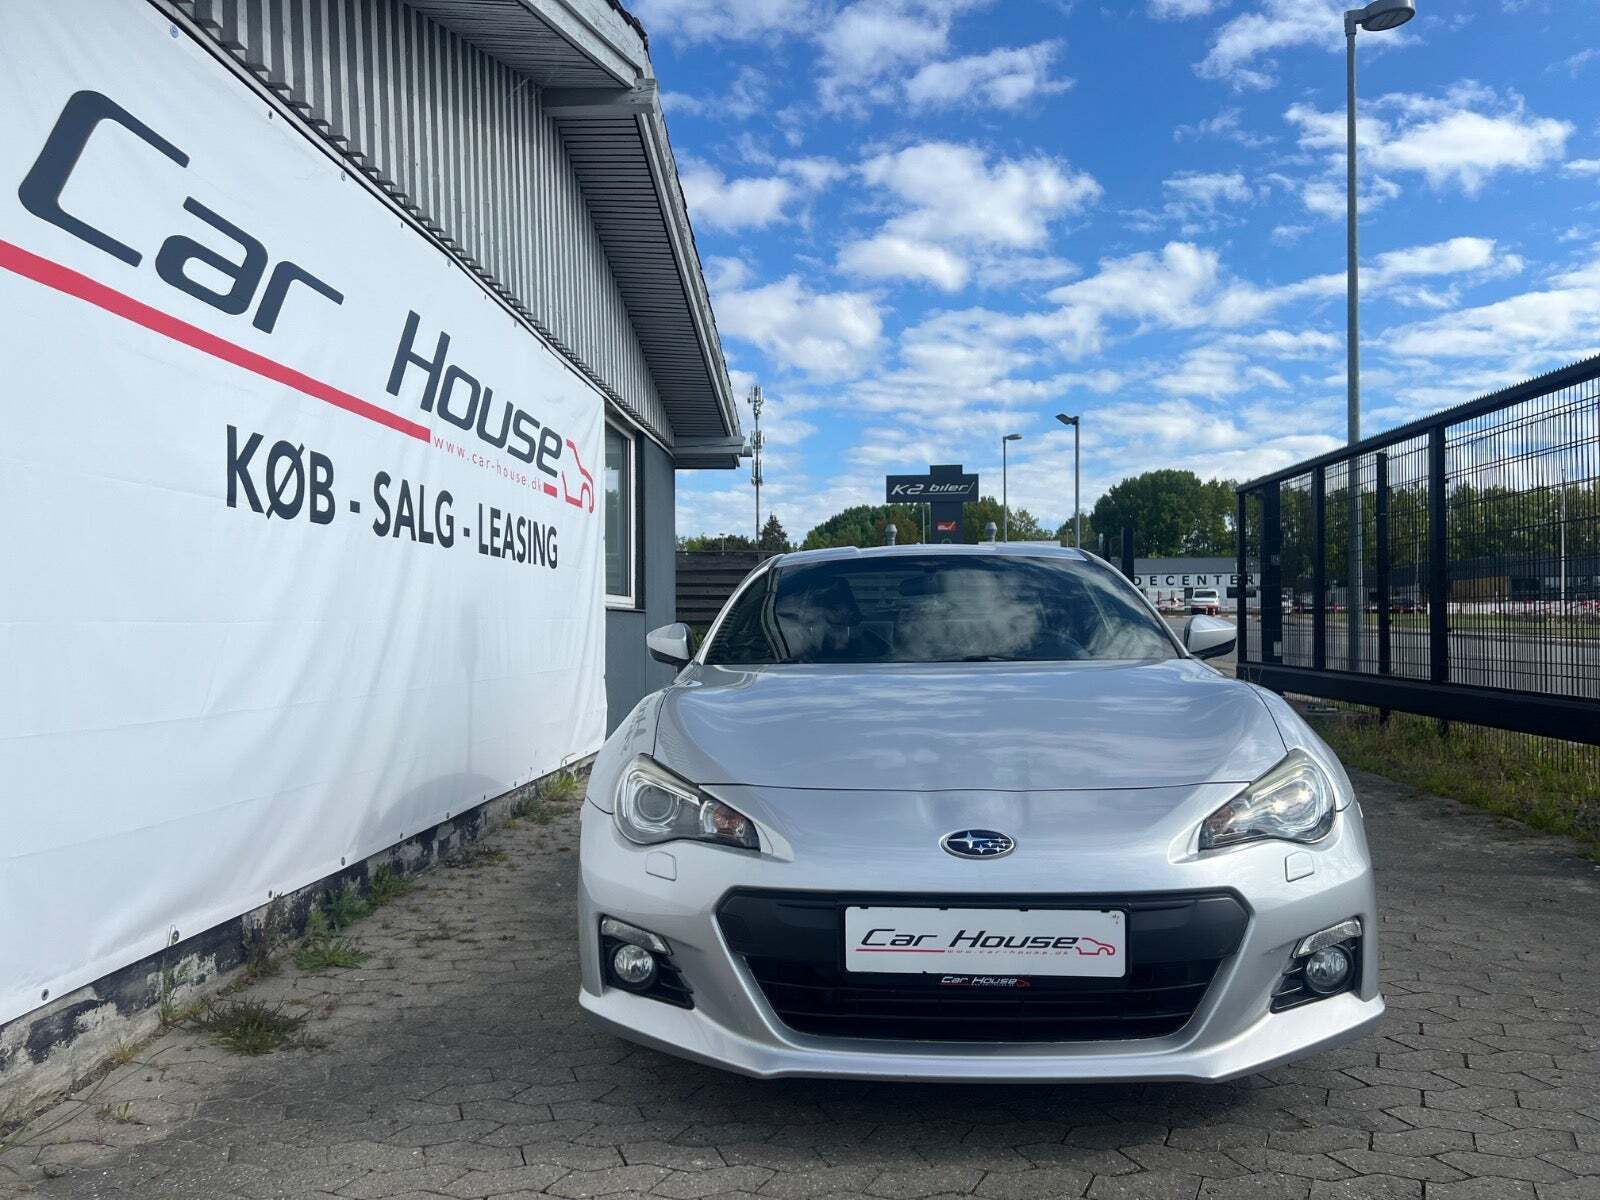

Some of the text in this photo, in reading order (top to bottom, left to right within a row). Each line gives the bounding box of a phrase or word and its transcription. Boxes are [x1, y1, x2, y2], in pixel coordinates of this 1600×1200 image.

[18, 90, 563, 479] Car House
[433, 434, 543, 492] www.car-house.dk
[226, 425, 336, 526] KØB
[373, 470, 455, 549] SALG
[478, 503, 558, 570] LEASING
[890, 483, 969, 495] K2 biler
[860, 929, 1080, 949] Car House
[941, 976, 1018, 985] Car House
